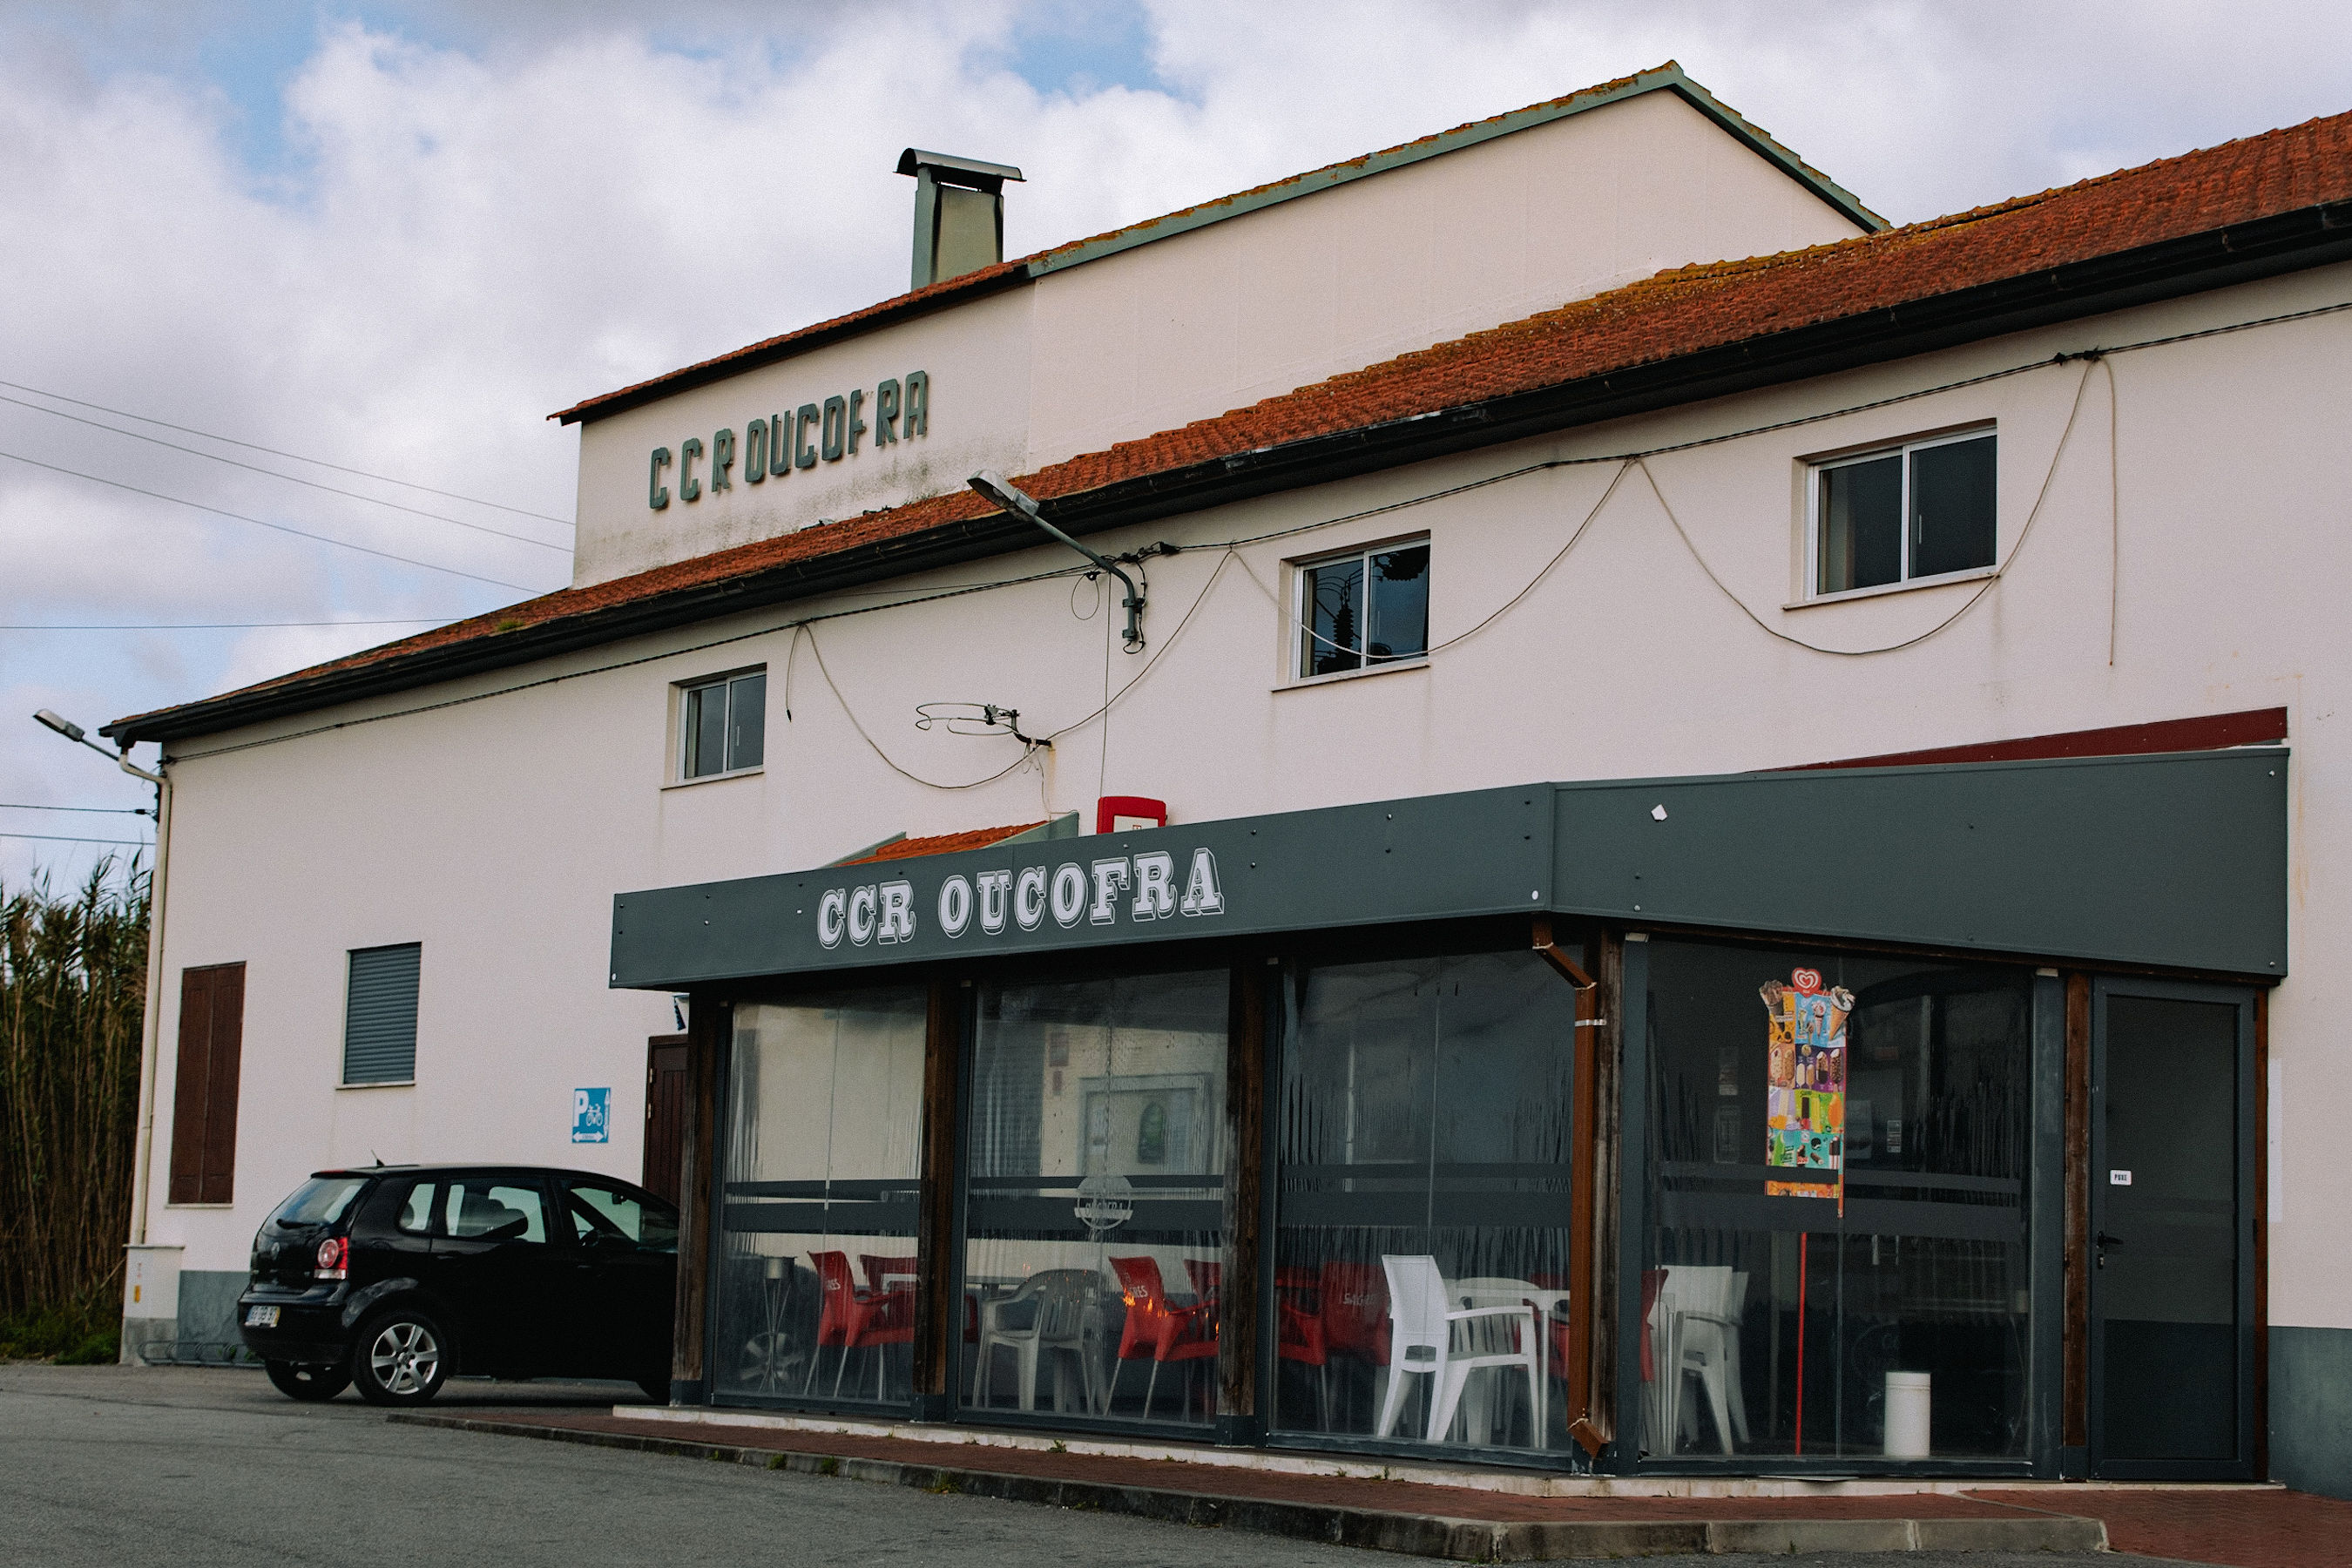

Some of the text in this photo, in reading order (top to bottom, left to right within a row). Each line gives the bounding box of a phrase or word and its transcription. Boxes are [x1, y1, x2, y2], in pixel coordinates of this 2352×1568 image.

[745, 370, 928, 483] OUCOFRA
[818, 848, 1225, 950] CCR OUCOFRA
[574, 1090, 590, 1127] P
